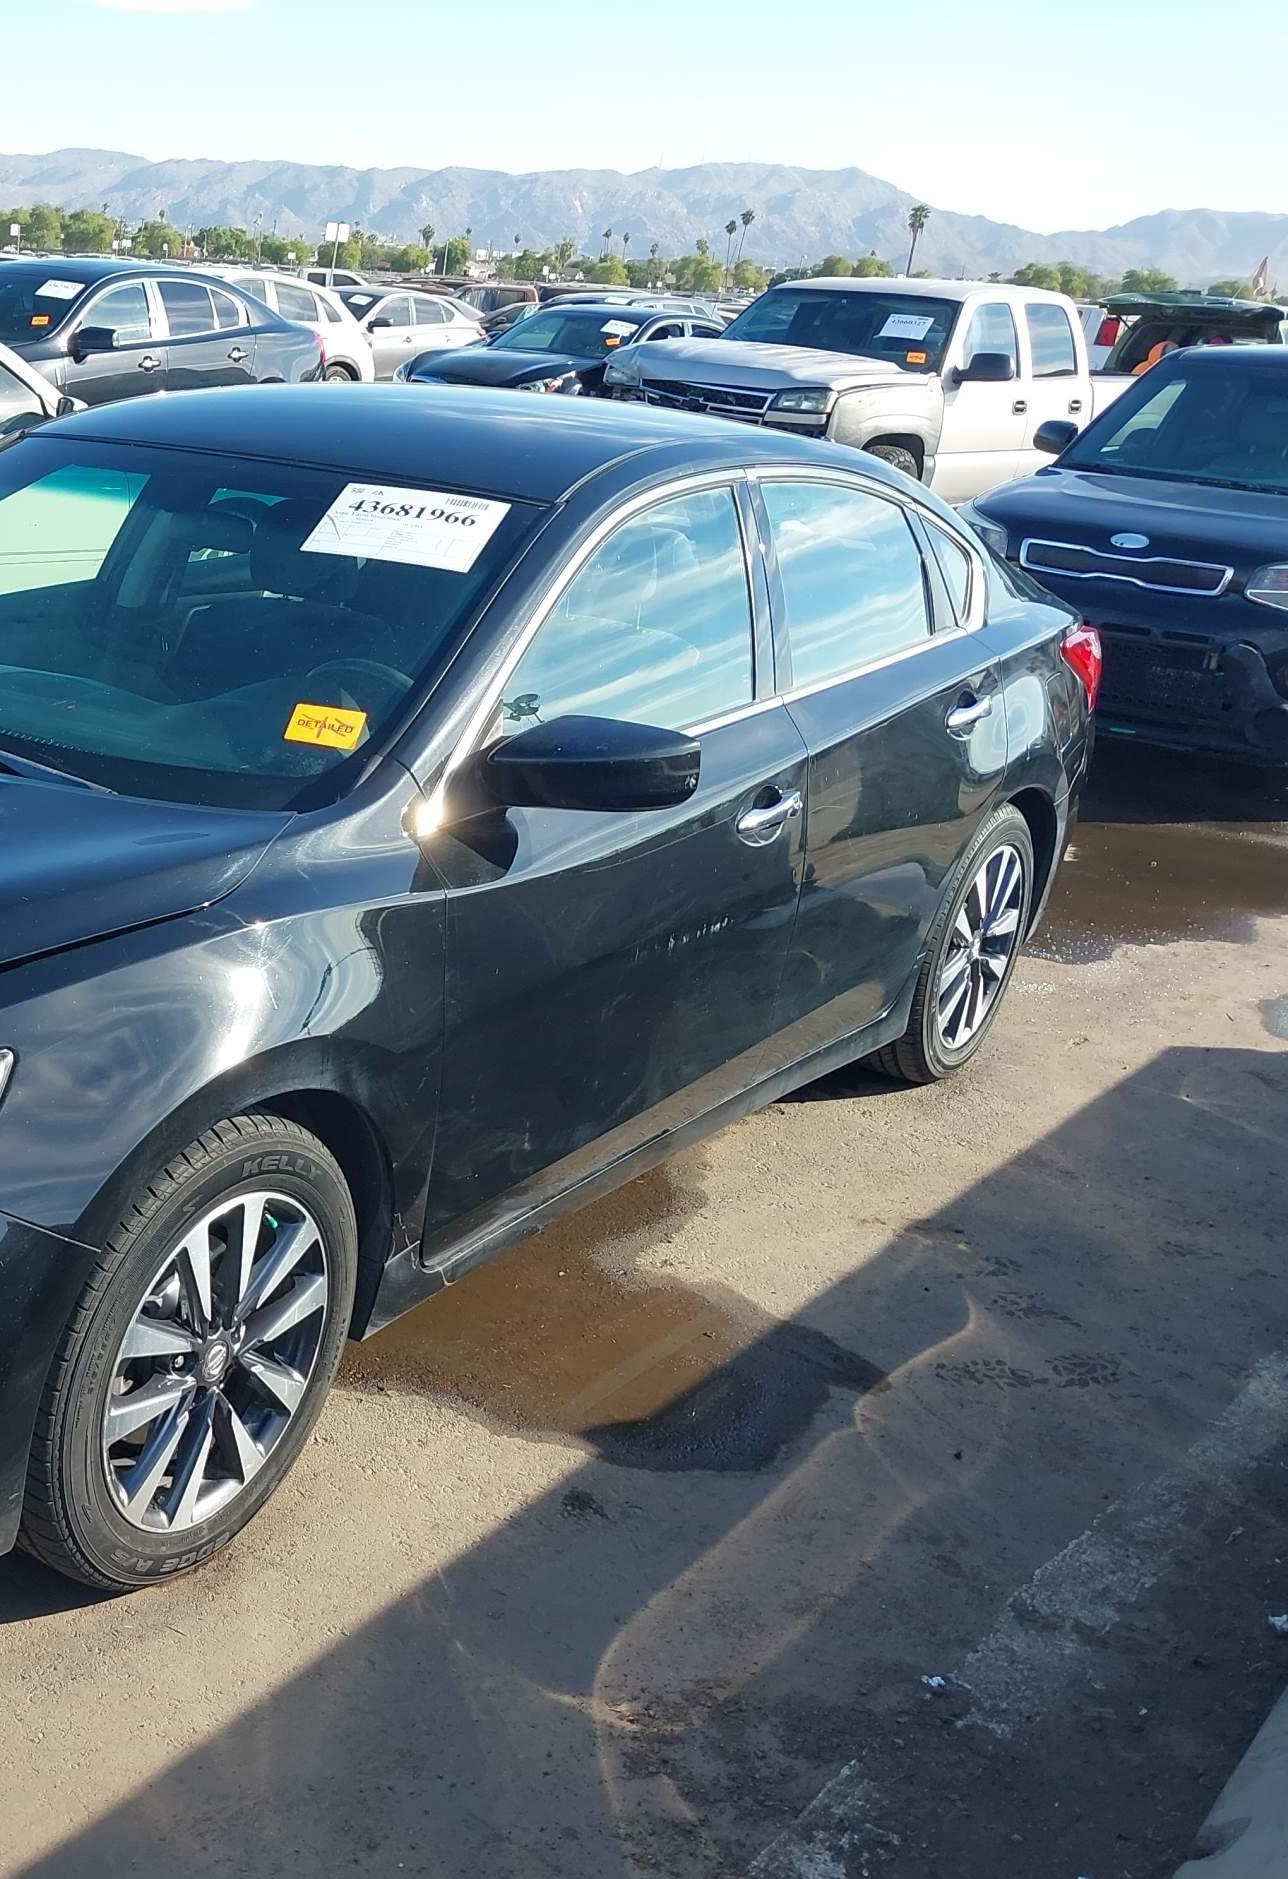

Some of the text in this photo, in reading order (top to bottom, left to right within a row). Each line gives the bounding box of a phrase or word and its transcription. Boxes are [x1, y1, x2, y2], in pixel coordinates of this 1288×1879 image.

[348, 499, 481, 527] 43681966
[296, 718, 355, 734] DETAILED
[241, 1155, 323, 1181] KELLY
